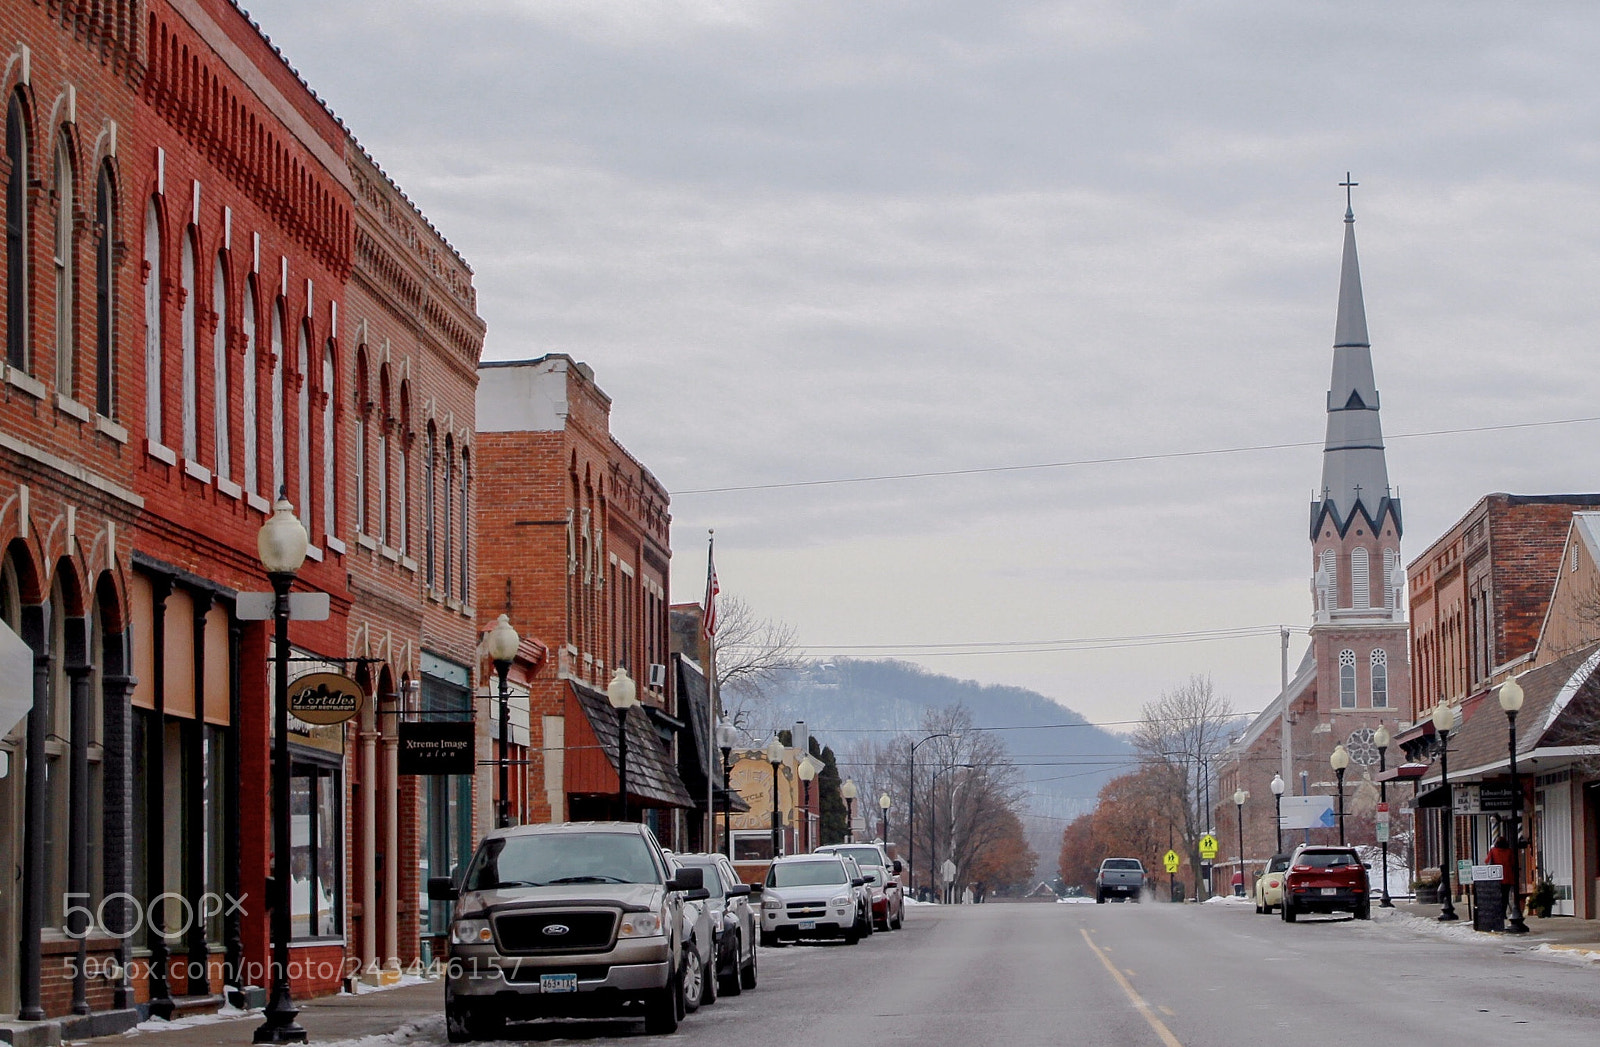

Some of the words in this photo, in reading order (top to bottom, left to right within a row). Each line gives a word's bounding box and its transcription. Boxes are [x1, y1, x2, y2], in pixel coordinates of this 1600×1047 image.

[293, 686, 355, 705] Portales
[406, 739, 439, 749] Xtreme
[441, 739, 468, 750] Image
